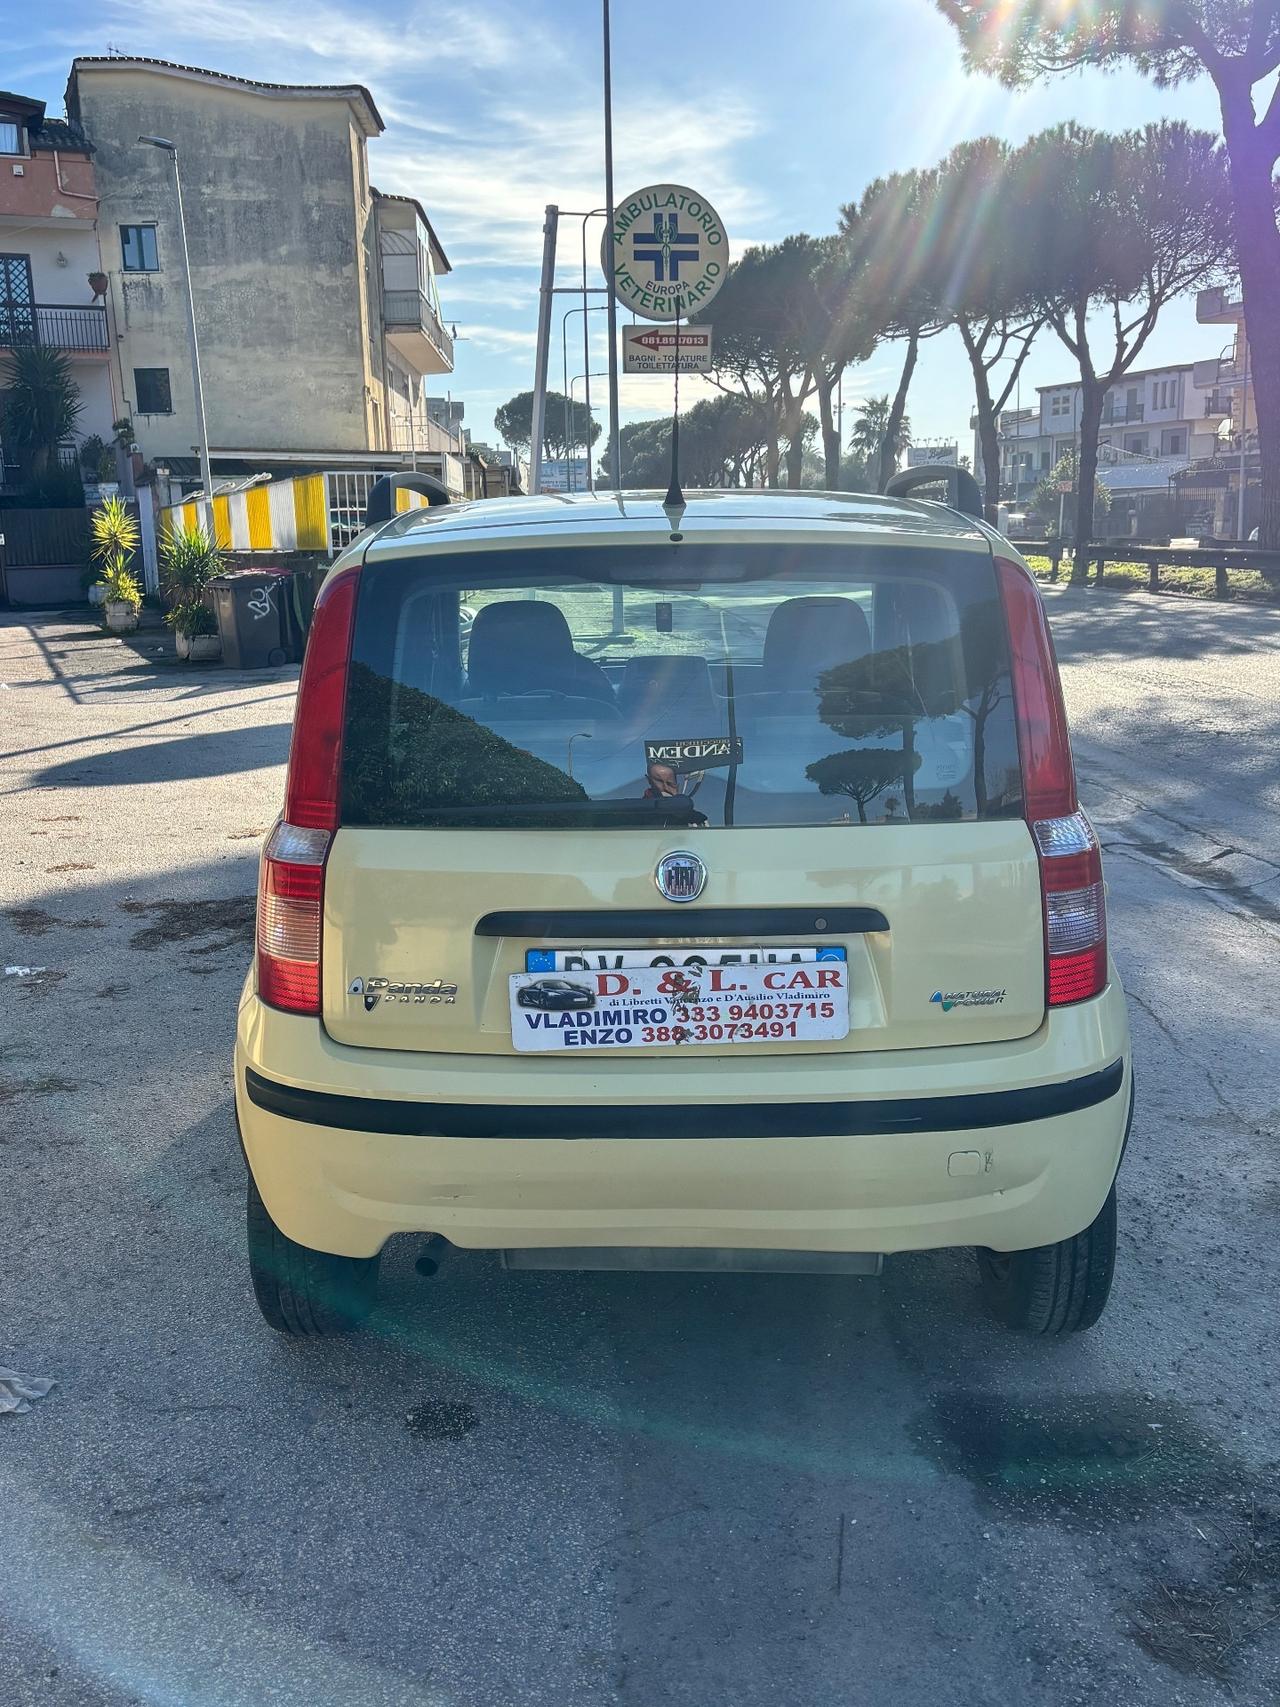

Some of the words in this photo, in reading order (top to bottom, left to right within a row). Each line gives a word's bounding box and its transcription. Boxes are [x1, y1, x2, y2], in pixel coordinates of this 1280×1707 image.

[611, 192, 722, 246] AMBULATORIO
[614, 262, 721, 313] VETERINARIO
[645, 280, 690, 296] EUROPA
[629, 354, 656, 362] BAGNI
[366, 977, 458, 995] Panda
[595, 973, 641, 996] D.
[657, 970, 696, 994] &
[709, 969, 748, 992] L.
[763, 969, 844, 990] CAR
[609, 998, 620, 1006] di
[622, 997, 662, 1006] Libretti
[664, 996, 713, 1005] Vcenzo
[724, 993, 774, 1003] D'Ausilio
[776, 991, 831, 1001] Vladimiro
[525, 1008, 668, 1029] VLADIMIRO
[676, 1006, 721, 1024] 333
[728, 1002, 835, 1021] 9403715
[564, 1028, 633, 1046] ENZO
[641, 1026, 685, 1043] 388
[694, 1021, 798, 1040] 3073491
